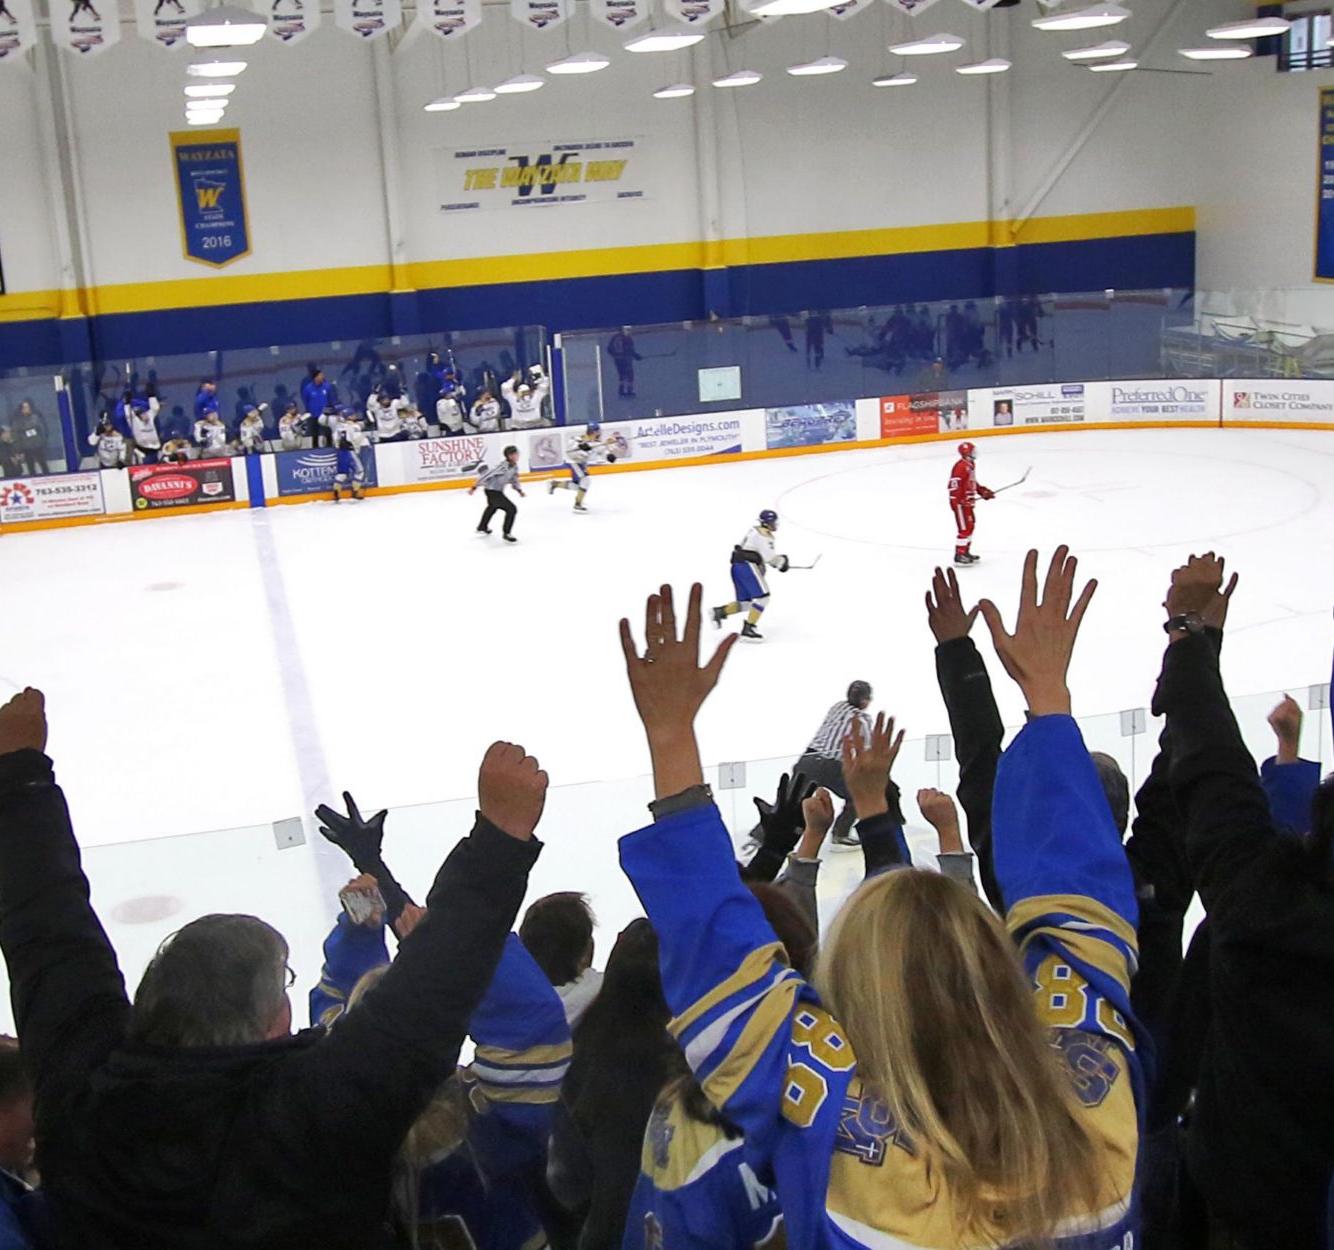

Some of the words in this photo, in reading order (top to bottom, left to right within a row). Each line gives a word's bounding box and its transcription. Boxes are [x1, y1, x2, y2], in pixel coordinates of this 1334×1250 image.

[464, 168, 500, 191] THE
[201, 235, 233, 248] 2016
[1112, 386, 1206, 404] PreferredOne
[1253, 391, 1280, 400] TWIN
[1281, 392, 1310, 401] CITIES
[1253, 401, 1287, 409] CLOSET
[1289, 401, 1333, 411] COMPANY
[418, 437, 484, 454] SUNSHINE
[422, 447, 482, 465] FACTORY
[143, 480, 193, 493] DAVANNI'S
